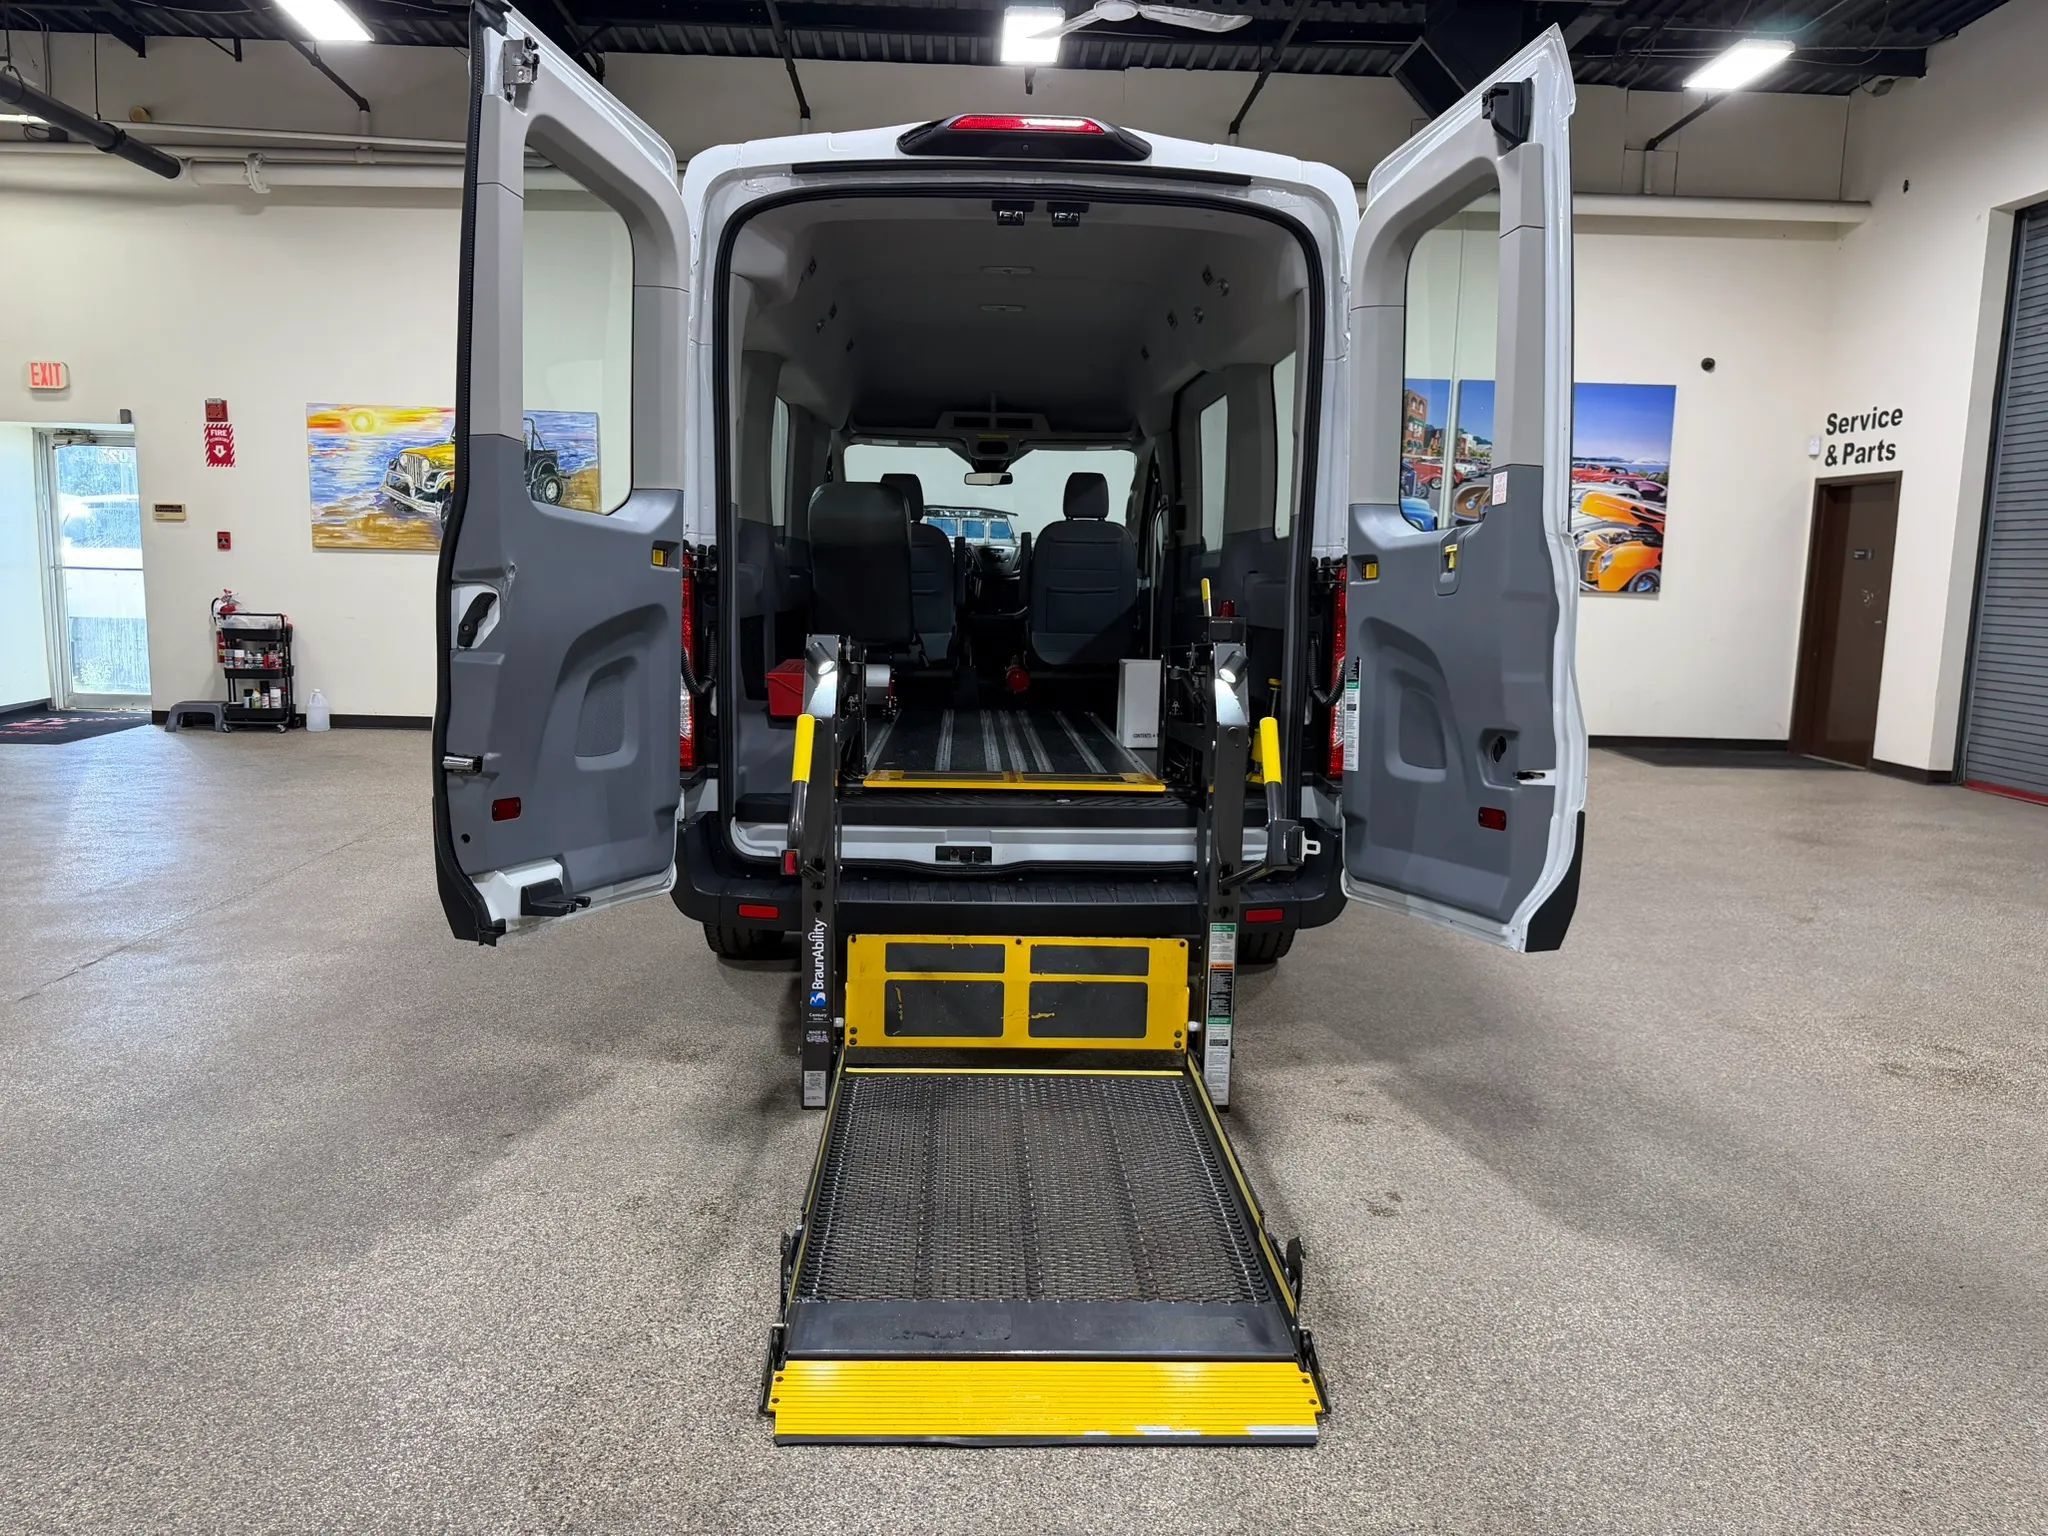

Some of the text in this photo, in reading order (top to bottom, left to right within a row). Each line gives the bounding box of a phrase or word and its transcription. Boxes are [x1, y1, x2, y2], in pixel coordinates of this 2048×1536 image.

[30, 362, 61, 386] EXIT
[210, 429, 228, 437] FIRE
[1826, 406, 1903, 436] Service
[1824, 439, 1896, 467] & Parts
[807, 917, 828, 990] BraunAbility
